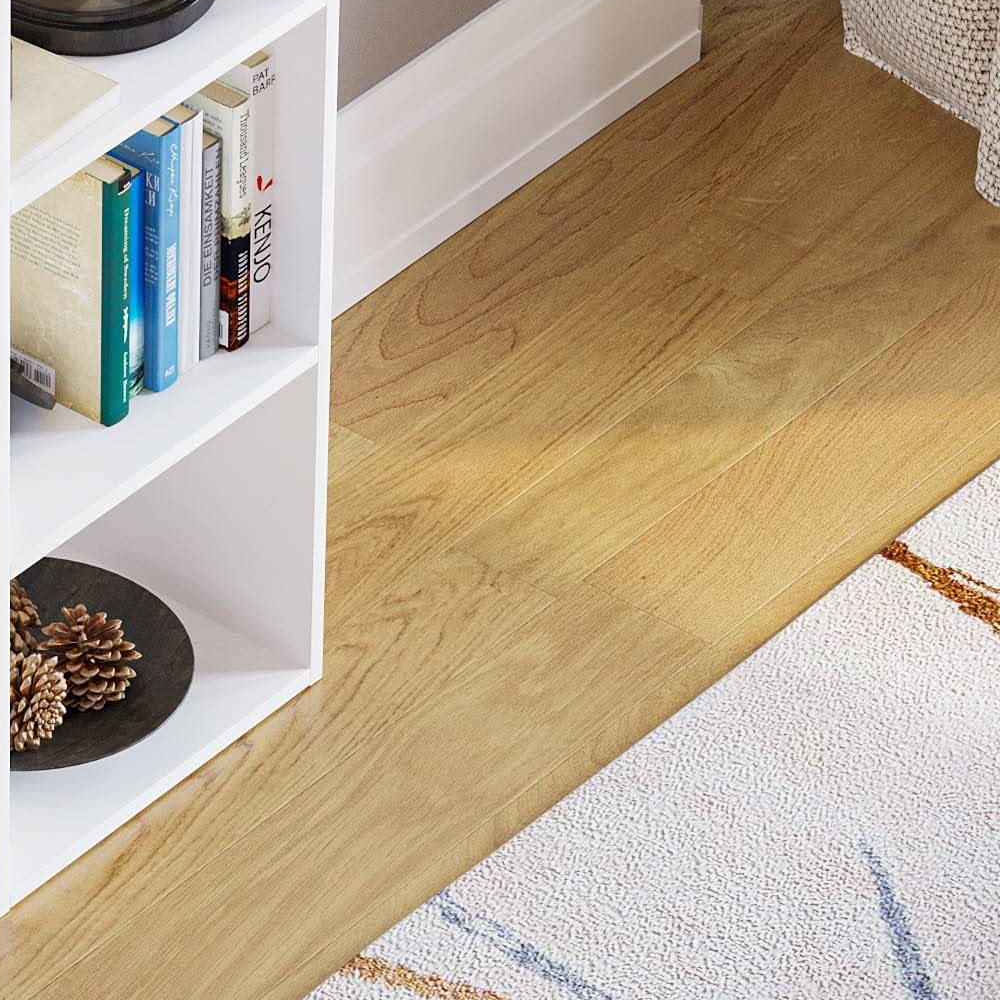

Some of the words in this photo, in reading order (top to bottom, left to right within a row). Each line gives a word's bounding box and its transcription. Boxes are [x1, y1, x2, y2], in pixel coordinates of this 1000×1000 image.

[252, 67, 270, 84] PAT
[239, 109, 249, 158] Thousand
[236, 157, 248, 199] Leagues
[204, 167, 213, 259] EINSAMKEIT
[253, 204, 272, 284] KENJO
[203, 261, 212, 288] DIE
